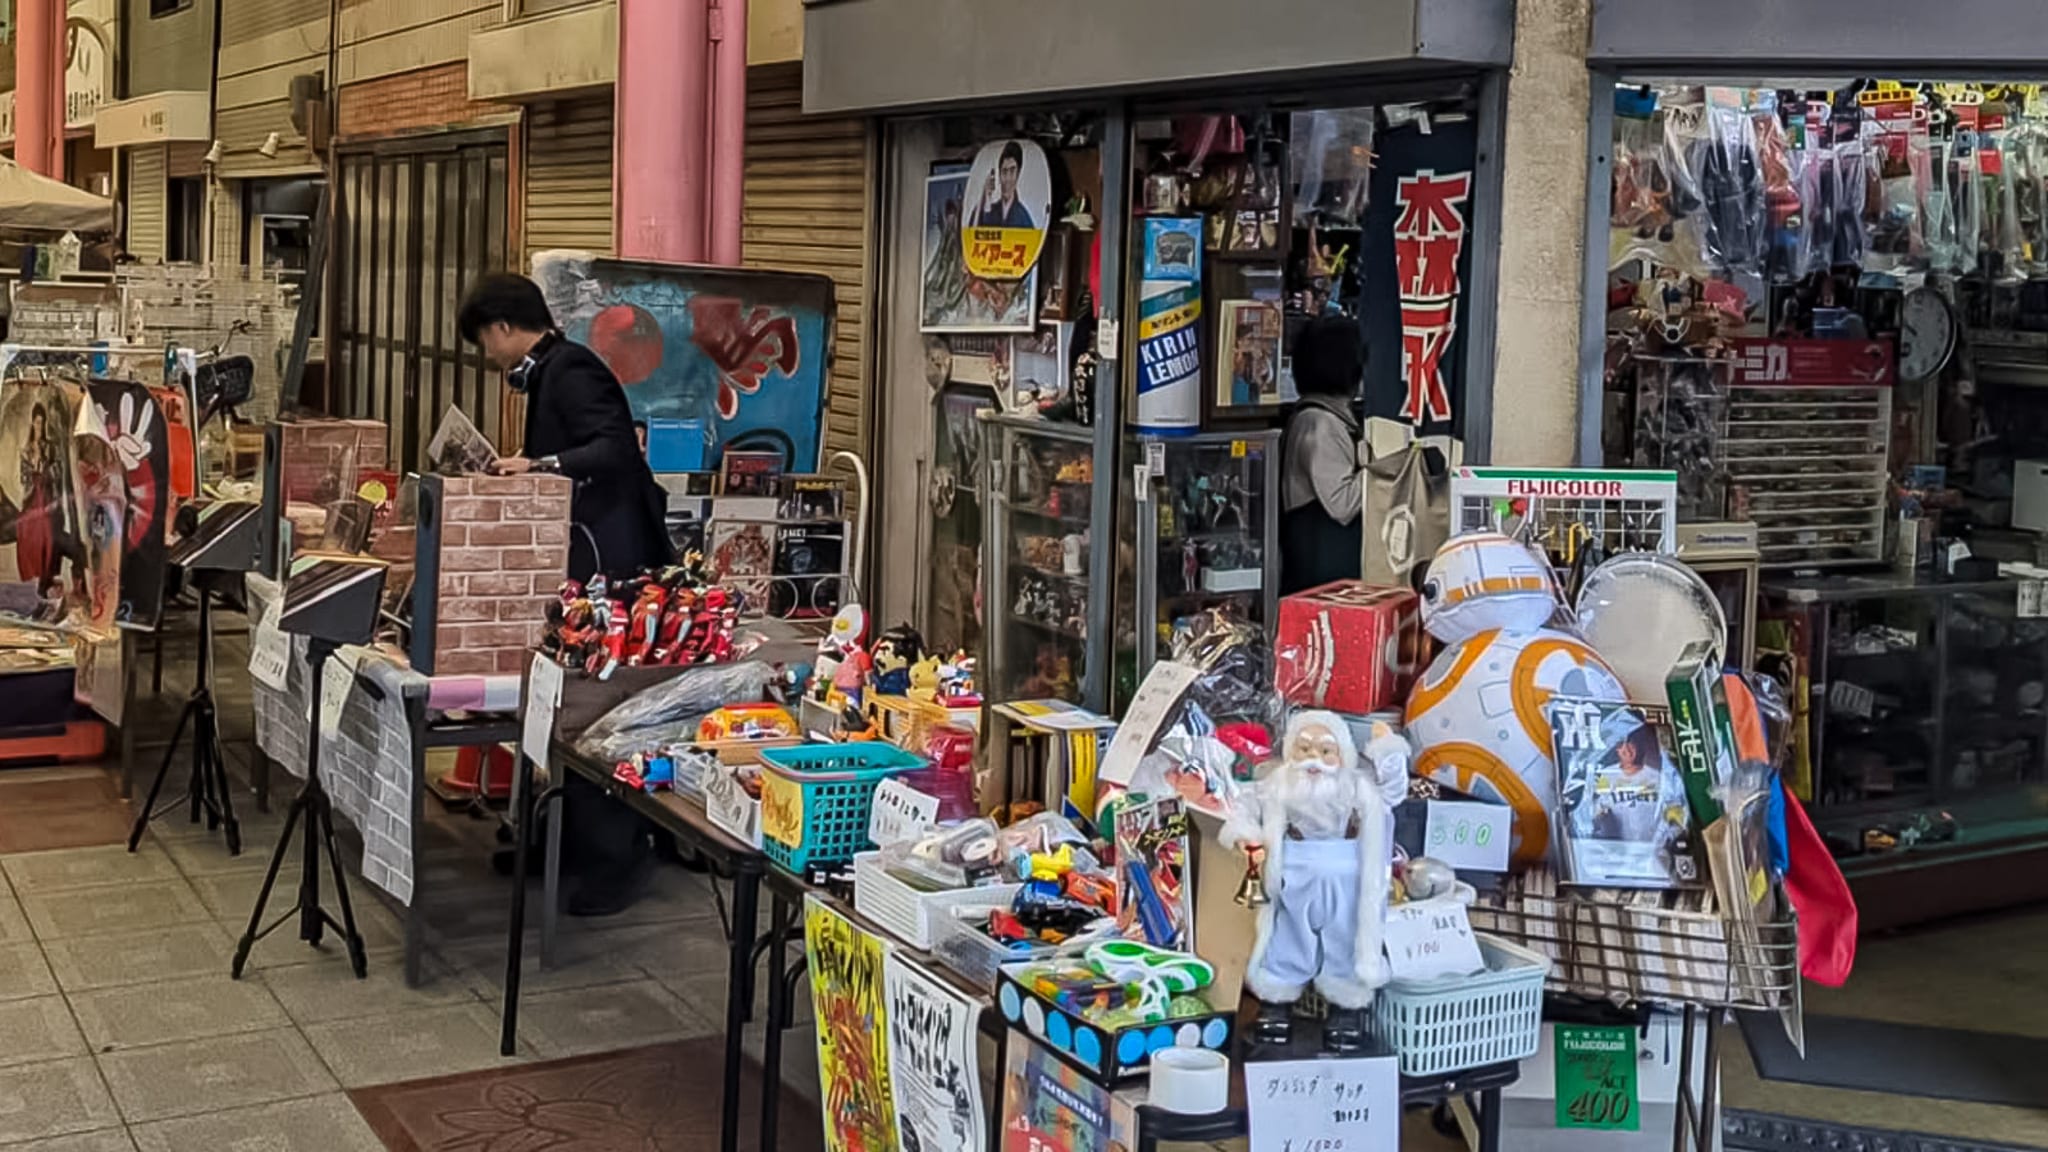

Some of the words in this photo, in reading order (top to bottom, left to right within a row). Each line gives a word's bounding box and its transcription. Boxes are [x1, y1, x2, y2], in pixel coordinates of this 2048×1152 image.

[1141, 328, 1196, 365] KIRIN
[1147, 347, 1199, 385] LEMON
[1508, 480, 1622, 496] FUJICOLOR
[1567, 1090, 1630, 1124] 400
